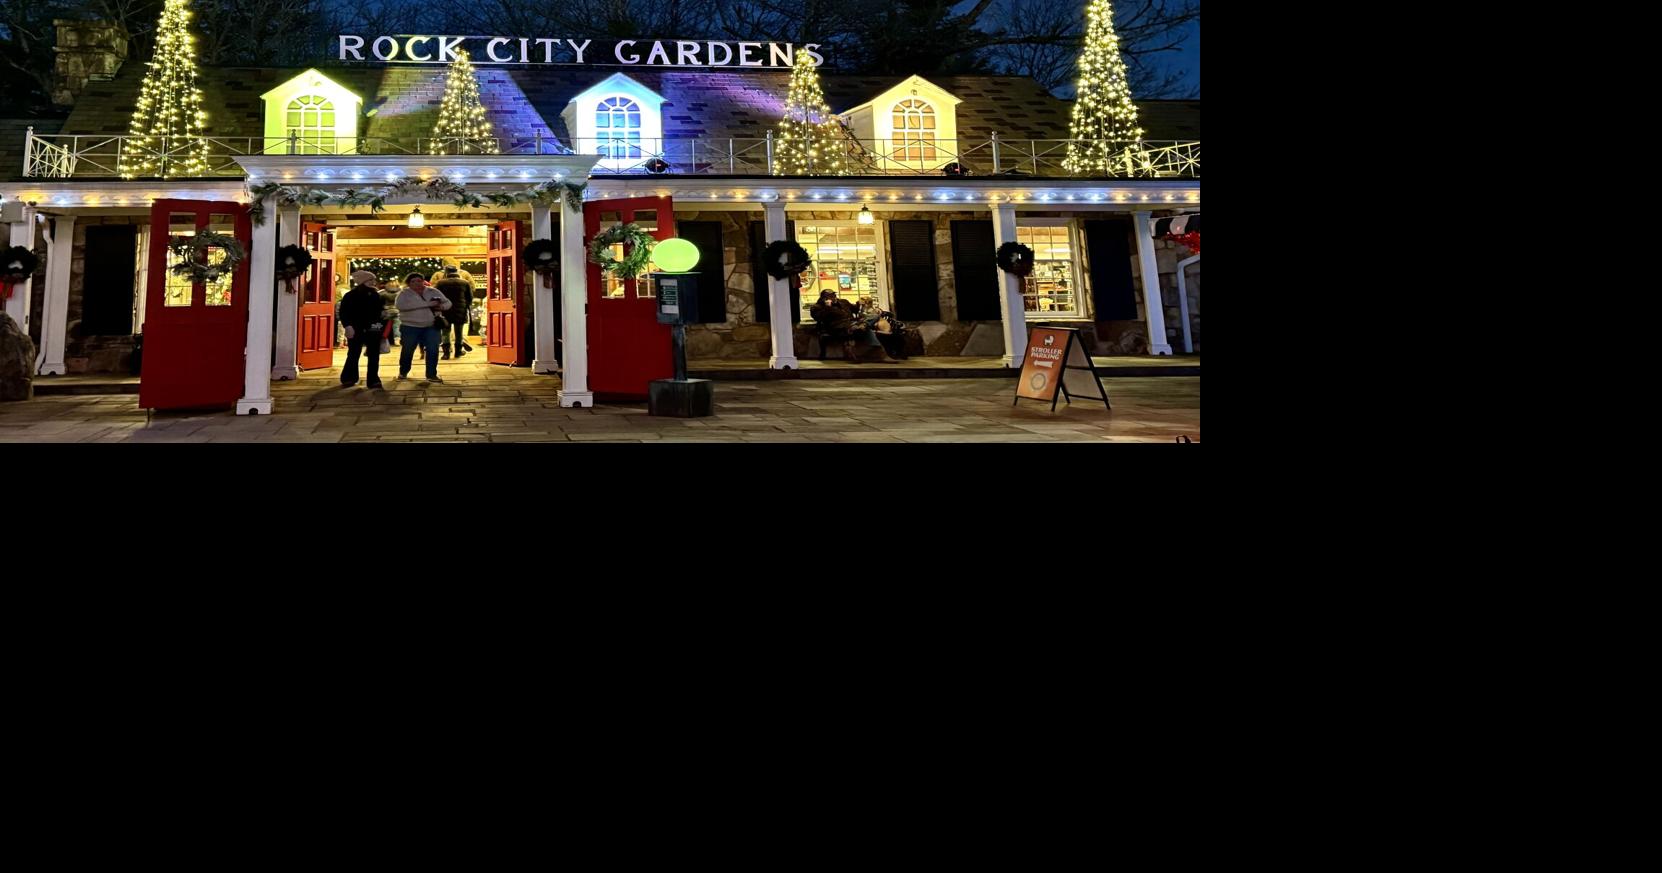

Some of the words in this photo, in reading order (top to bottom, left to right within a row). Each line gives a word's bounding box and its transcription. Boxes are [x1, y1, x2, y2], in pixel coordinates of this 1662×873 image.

[339, 35, 465, 62] ROCK
[486, 37, 592, 63] CITY
[614, 39, 824, 67] GARDENS
[1031, 346, 1062, 355] STROLLER
[1031, 352, 1059, 360] PARKING
